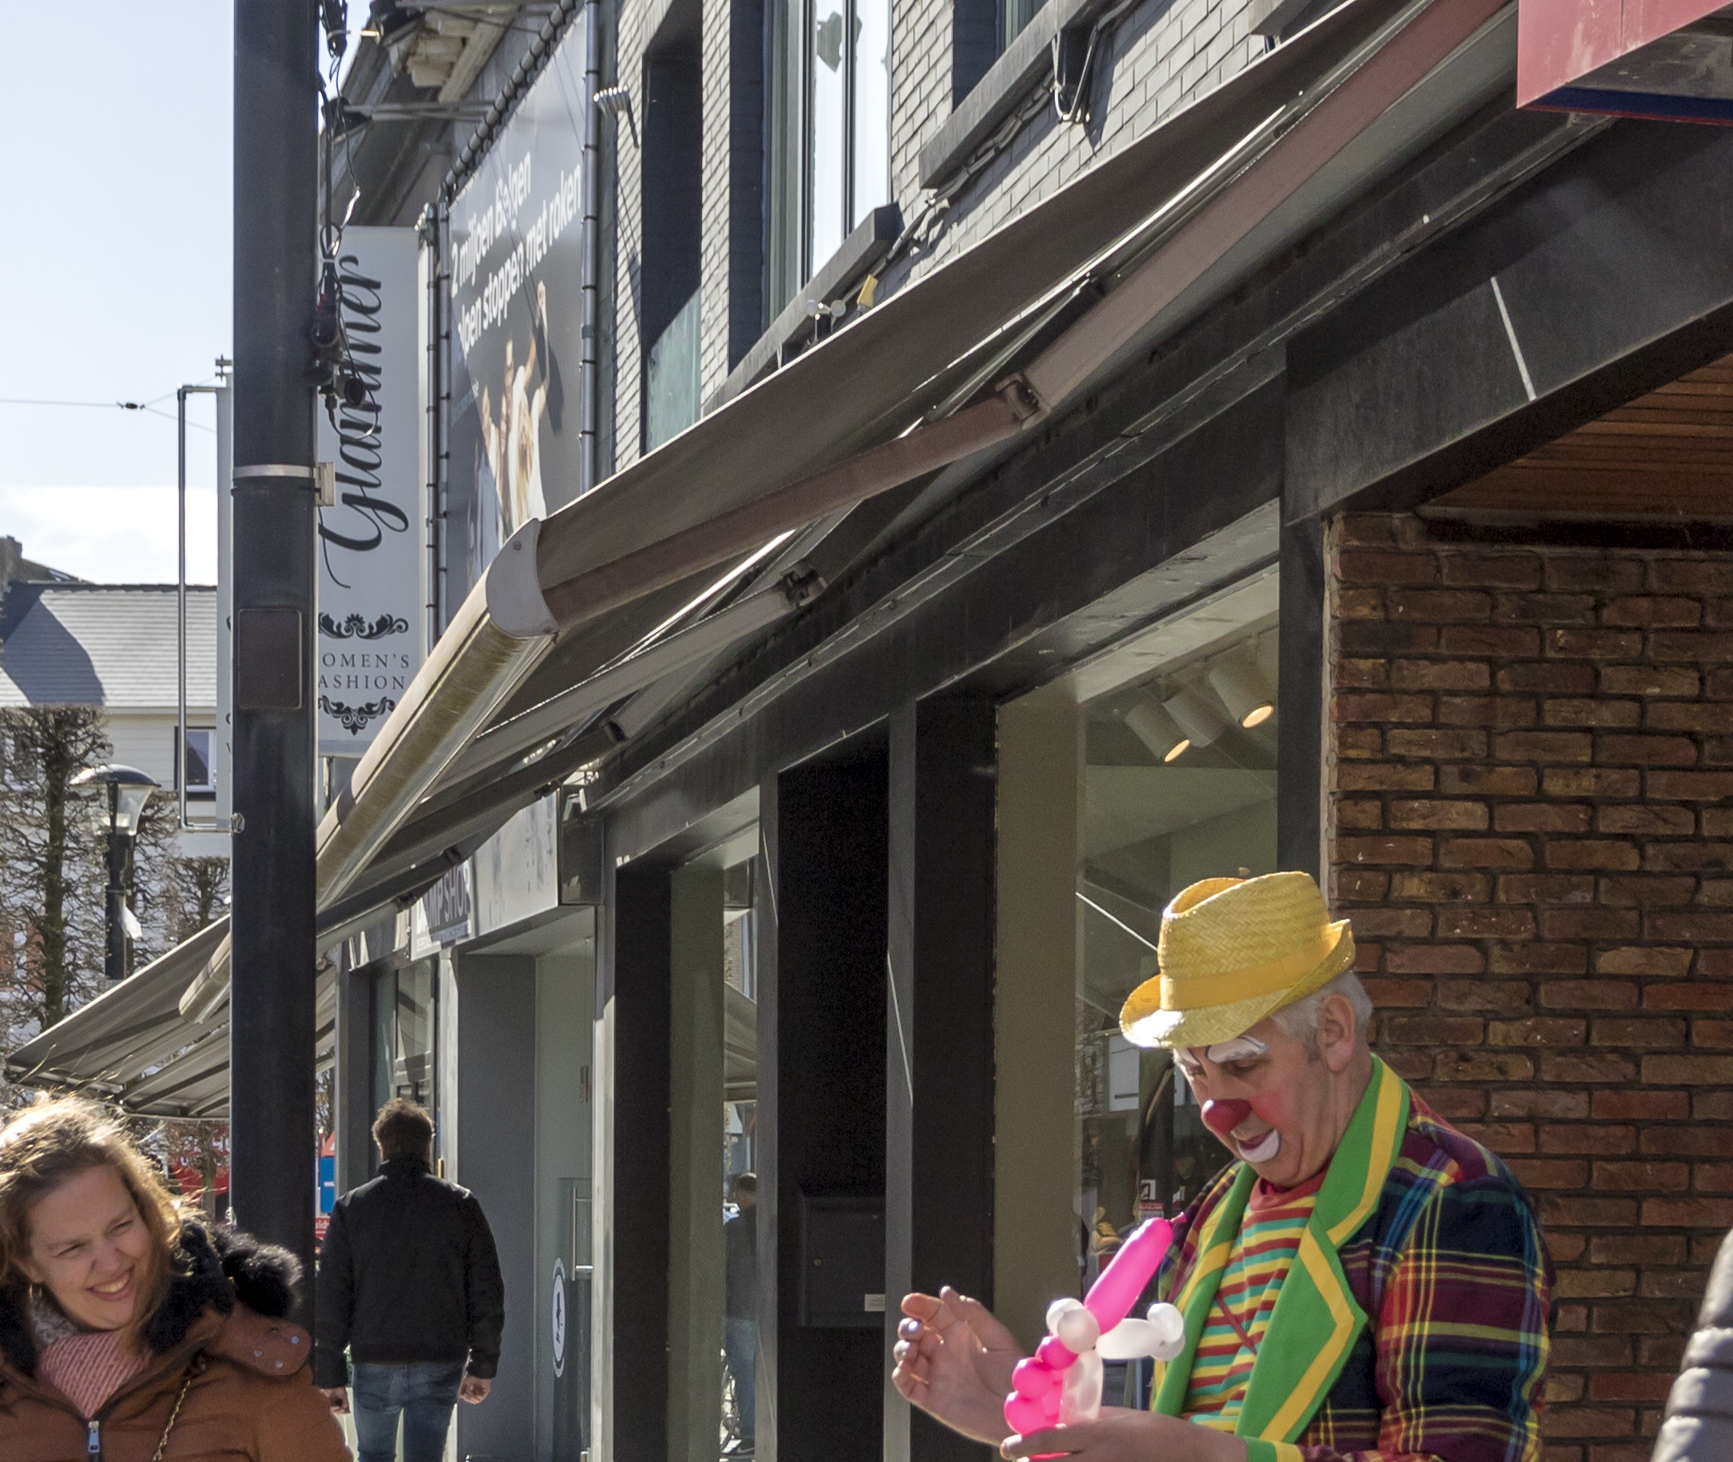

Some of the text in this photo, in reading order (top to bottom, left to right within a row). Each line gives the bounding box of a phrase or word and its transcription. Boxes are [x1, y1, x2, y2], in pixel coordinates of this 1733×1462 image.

[451, 150, 531, 299] 2 miljoen Belgen
[483, 241, 524, 331] stoppen
[526, 198, 548, 277] met
[549, 162, 581, 247] roken
[318, 674, 406, 690] ASHION
[322, 652, 410, 669] OMEN'S
